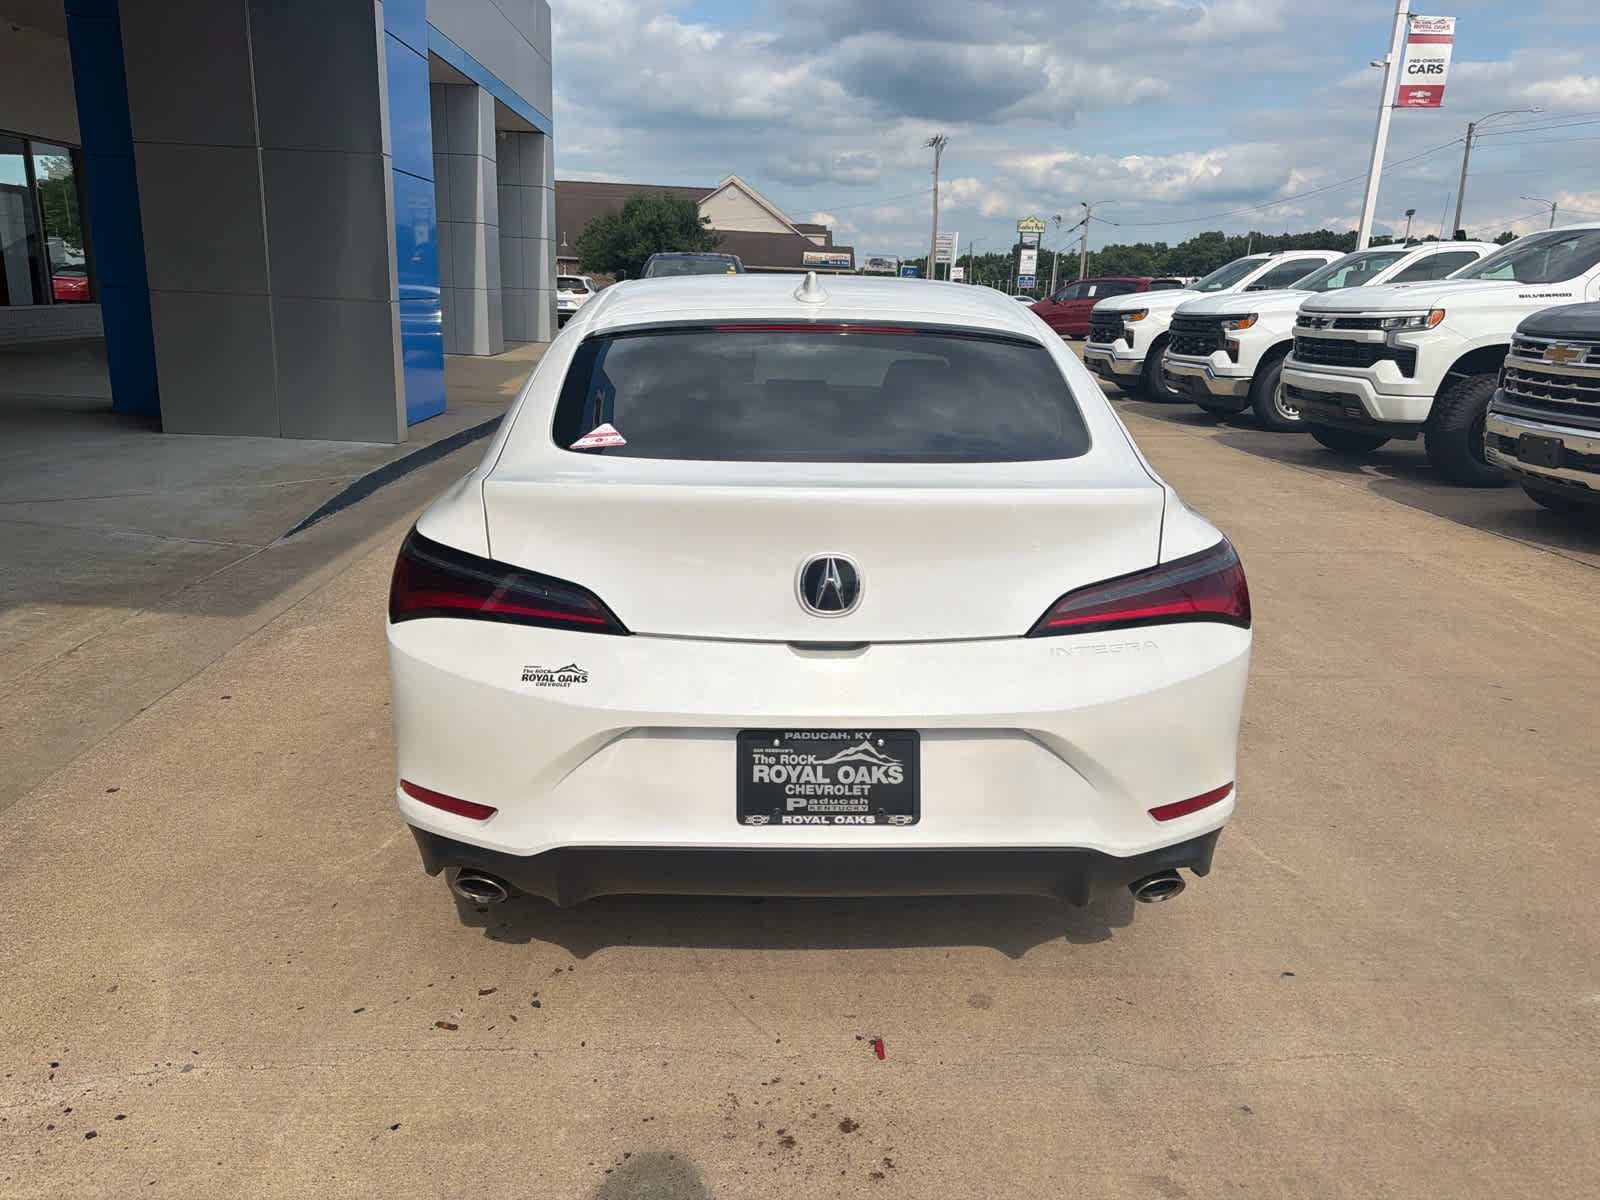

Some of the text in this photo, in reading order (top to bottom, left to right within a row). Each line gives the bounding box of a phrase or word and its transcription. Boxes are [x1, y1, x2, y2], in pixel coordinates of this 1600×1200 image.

[1408, 64, 1444, 74] CARS
[1049, 640, 1159, 656] INTEGRA
[522, 674, 588, 683] ROYAL OAKS
[752, 754, 816, 764] The ROCK
[753, 765, 904, 784] ROYAL OAKS
[785, 784, 871, 795] CHEVROLET
[782, 815, 875, 823] ROYAL OAKS
